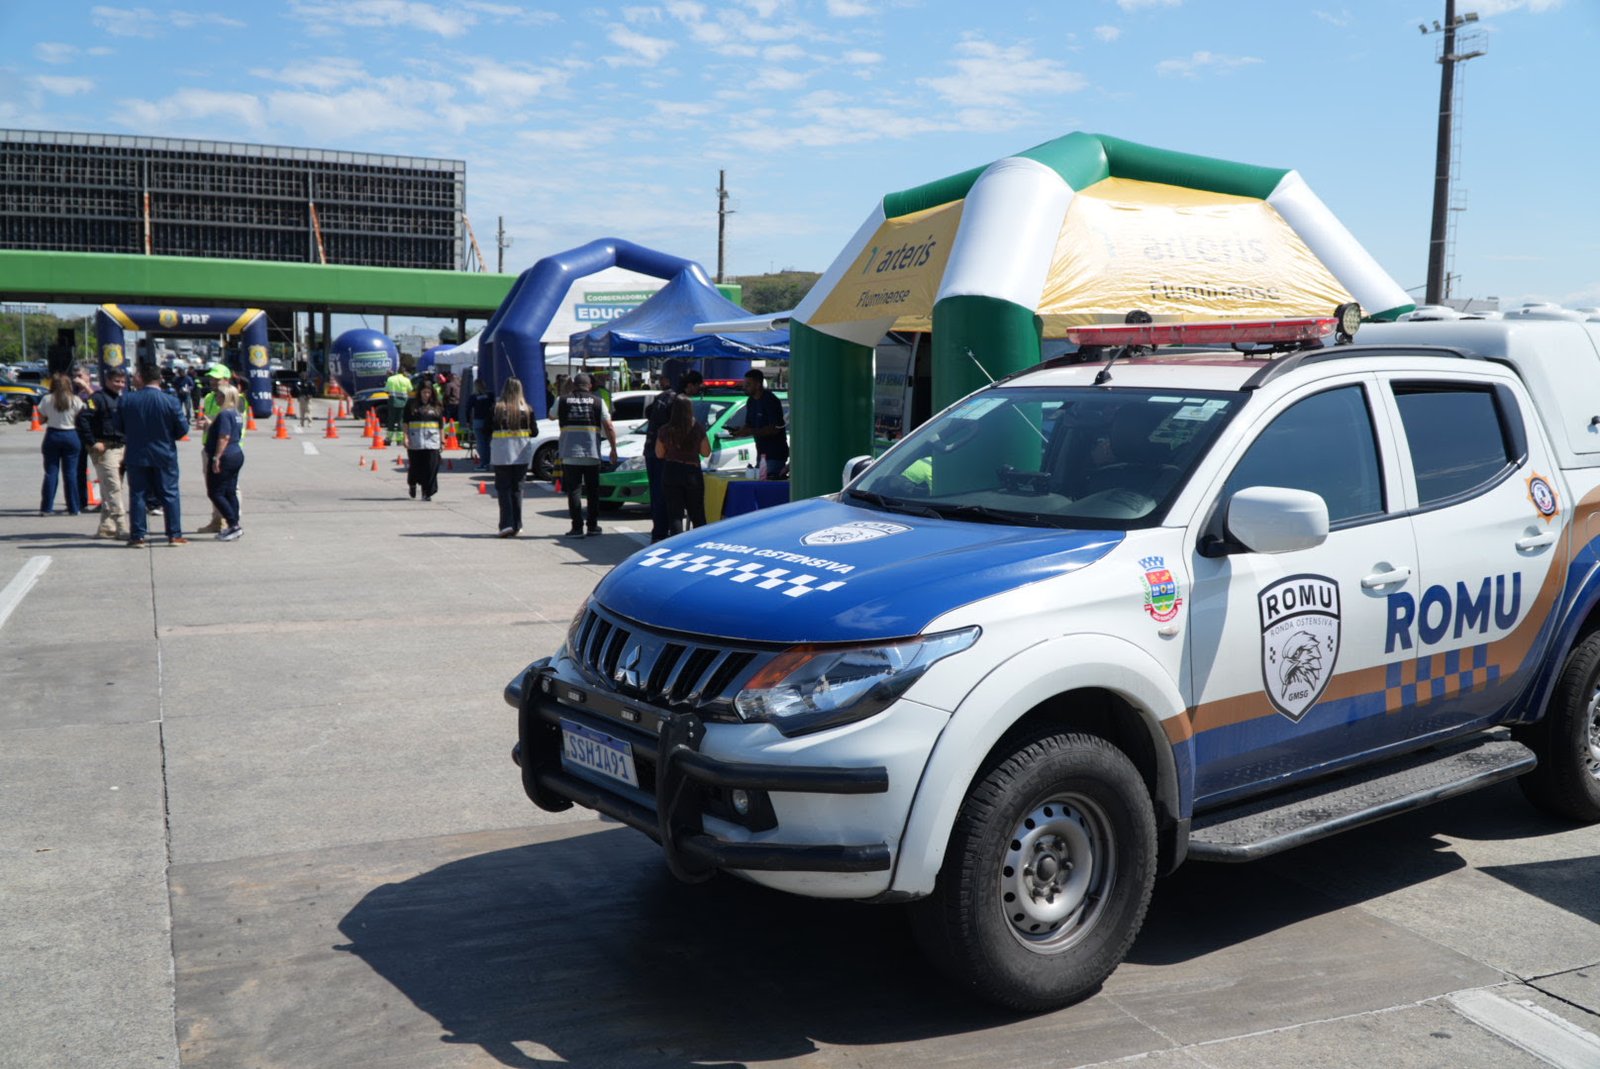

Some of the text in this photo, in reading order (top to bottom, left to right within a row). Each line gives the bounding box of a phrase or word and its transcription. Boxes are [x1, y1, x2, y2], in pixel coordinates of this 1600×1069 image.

[876, 234, 937, 273] arteris
[1143, 231, 1267, 264] arteris
[856, 289, 911, 308] Fluminense
[1150, 281, 1281, 300] Fluminense
[182, 313, 210, 324] PRF
[577, 307, 634, 320] EDUC
[250, 369, 270, 378] PRF
[694, 541, 856, 574] RONDA OSTENSIVA
[1266, 584, 1332, 620] ROMU
[1385, 571, 1522, 654] ROMU
[1270, 617, 1333, 637] RONDA OSTENSIVA
[1288, 689, 1309, 701] GMSG
[569, 735, 630, 780] SSH1A91
